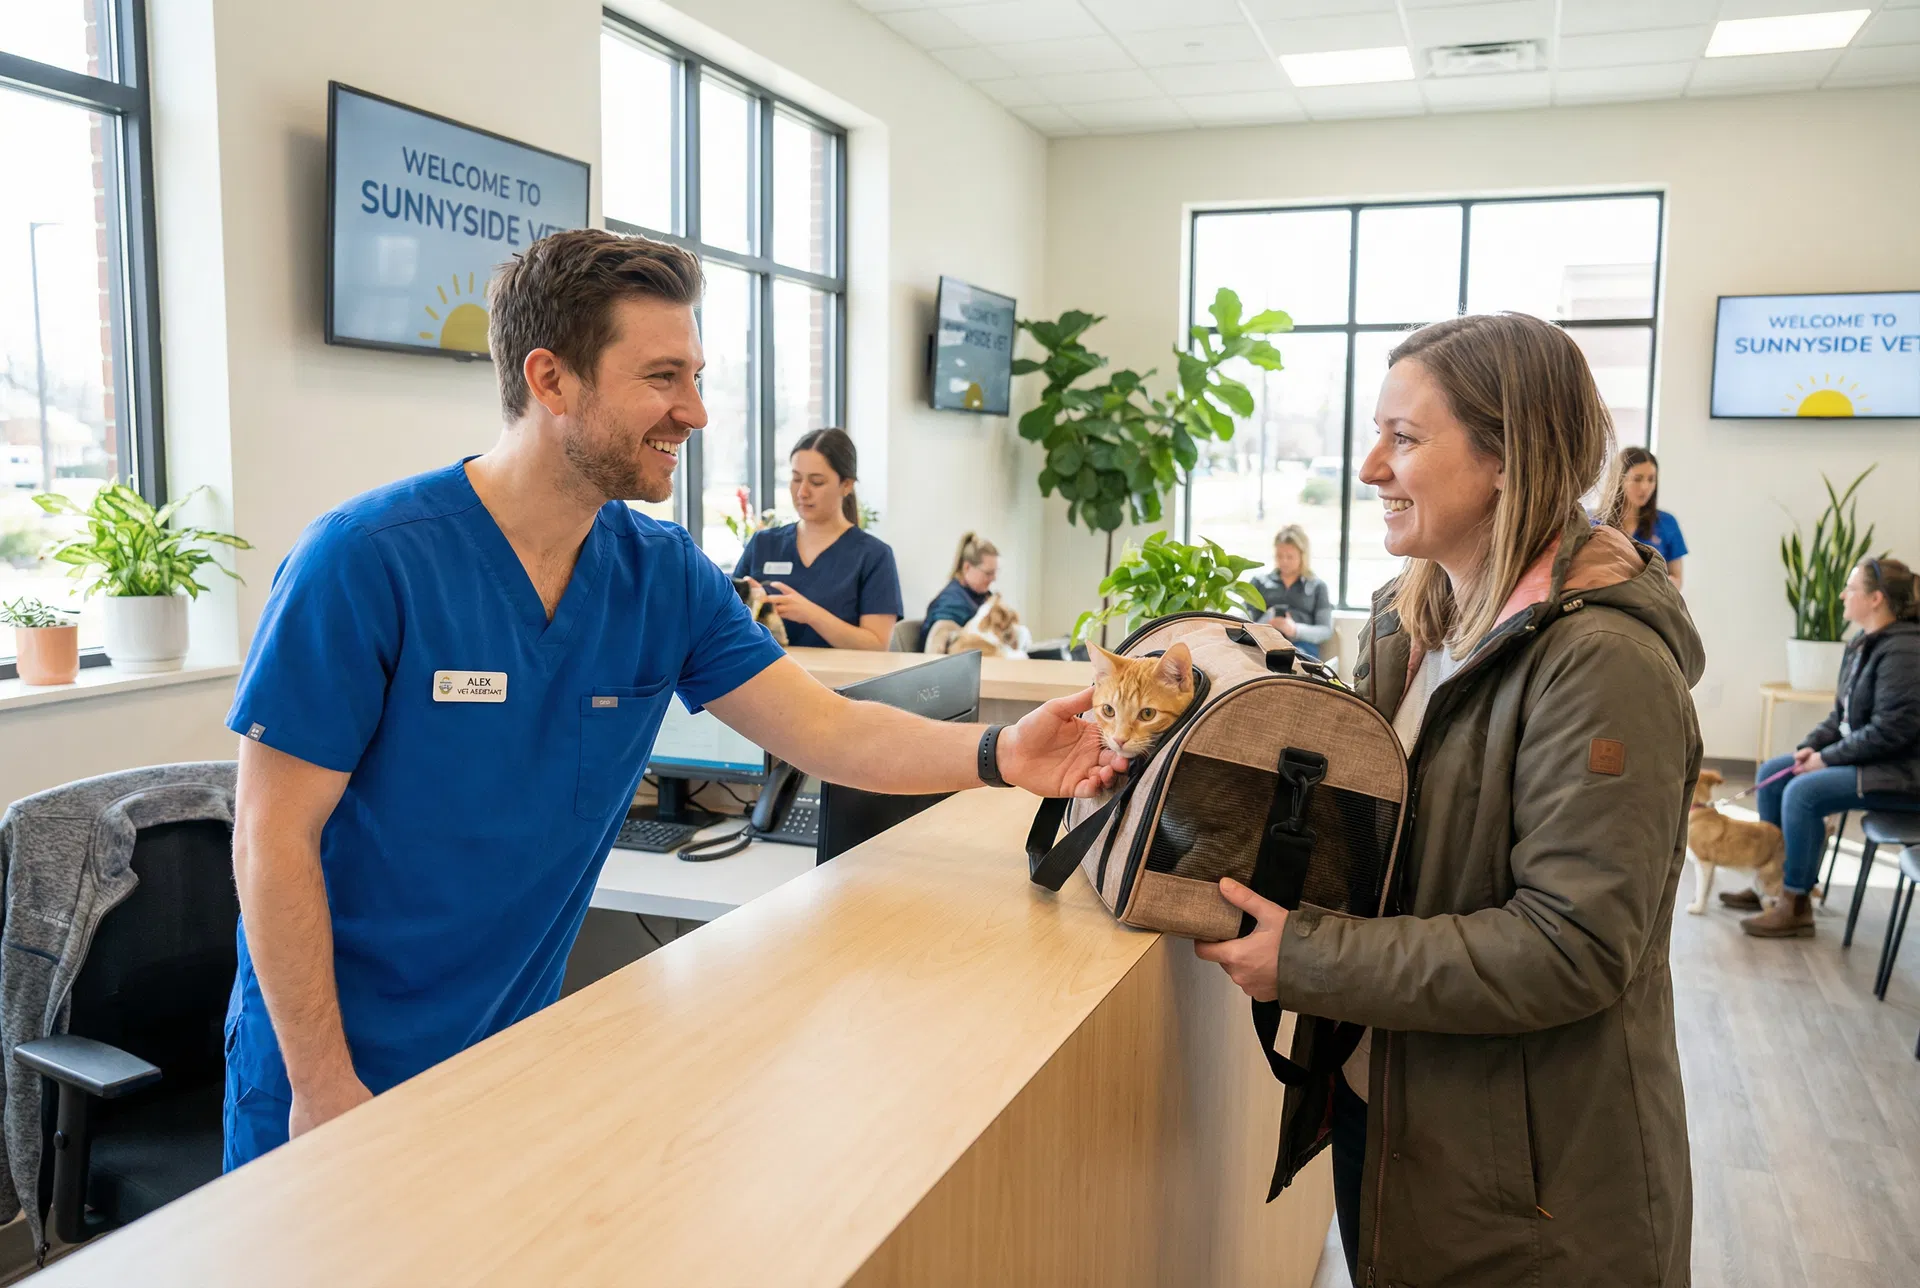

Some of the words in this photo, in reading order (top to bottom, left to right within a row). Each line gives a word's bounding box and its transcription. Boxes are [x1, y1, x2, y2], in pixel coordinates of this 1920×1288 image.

[402, 146, 510, 199] WELCOME
[516, 179, 541, 207] TO
[361, 179, 520, 246] SUNNYSIDE
[1768, 314, 1864, 329] WELCOME
[1871, 313, 1897, 328] TO
[1735, 335, 1873, 354] SUNNYSIDE
[467, 678, 491, 686] ALEX
